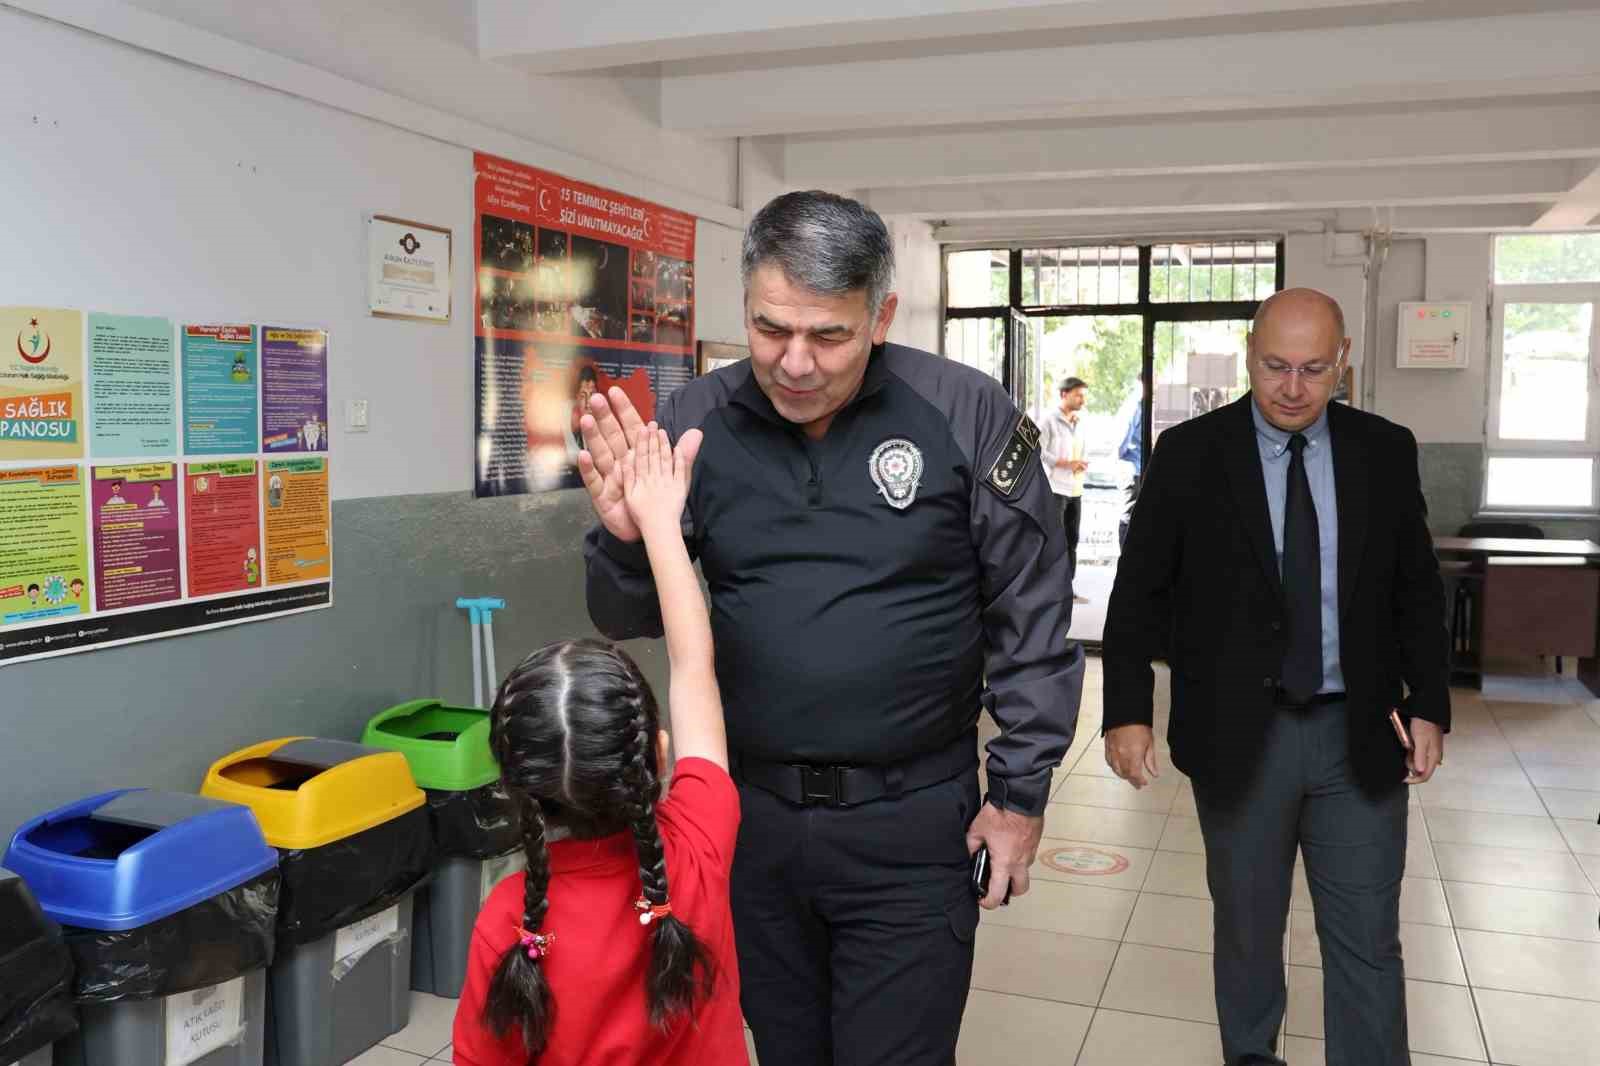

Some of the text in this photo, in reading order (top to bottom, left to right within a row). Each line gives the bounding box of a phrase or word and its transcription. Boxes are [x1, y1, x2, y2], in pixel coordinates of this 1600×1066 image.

[561, 187, 571, 201] 15
[573, 190, 608, 212] TEMMUZ
[4, 396, 68, 418] SAĞLIK
[0, 421, 71, 437] PANOSU
